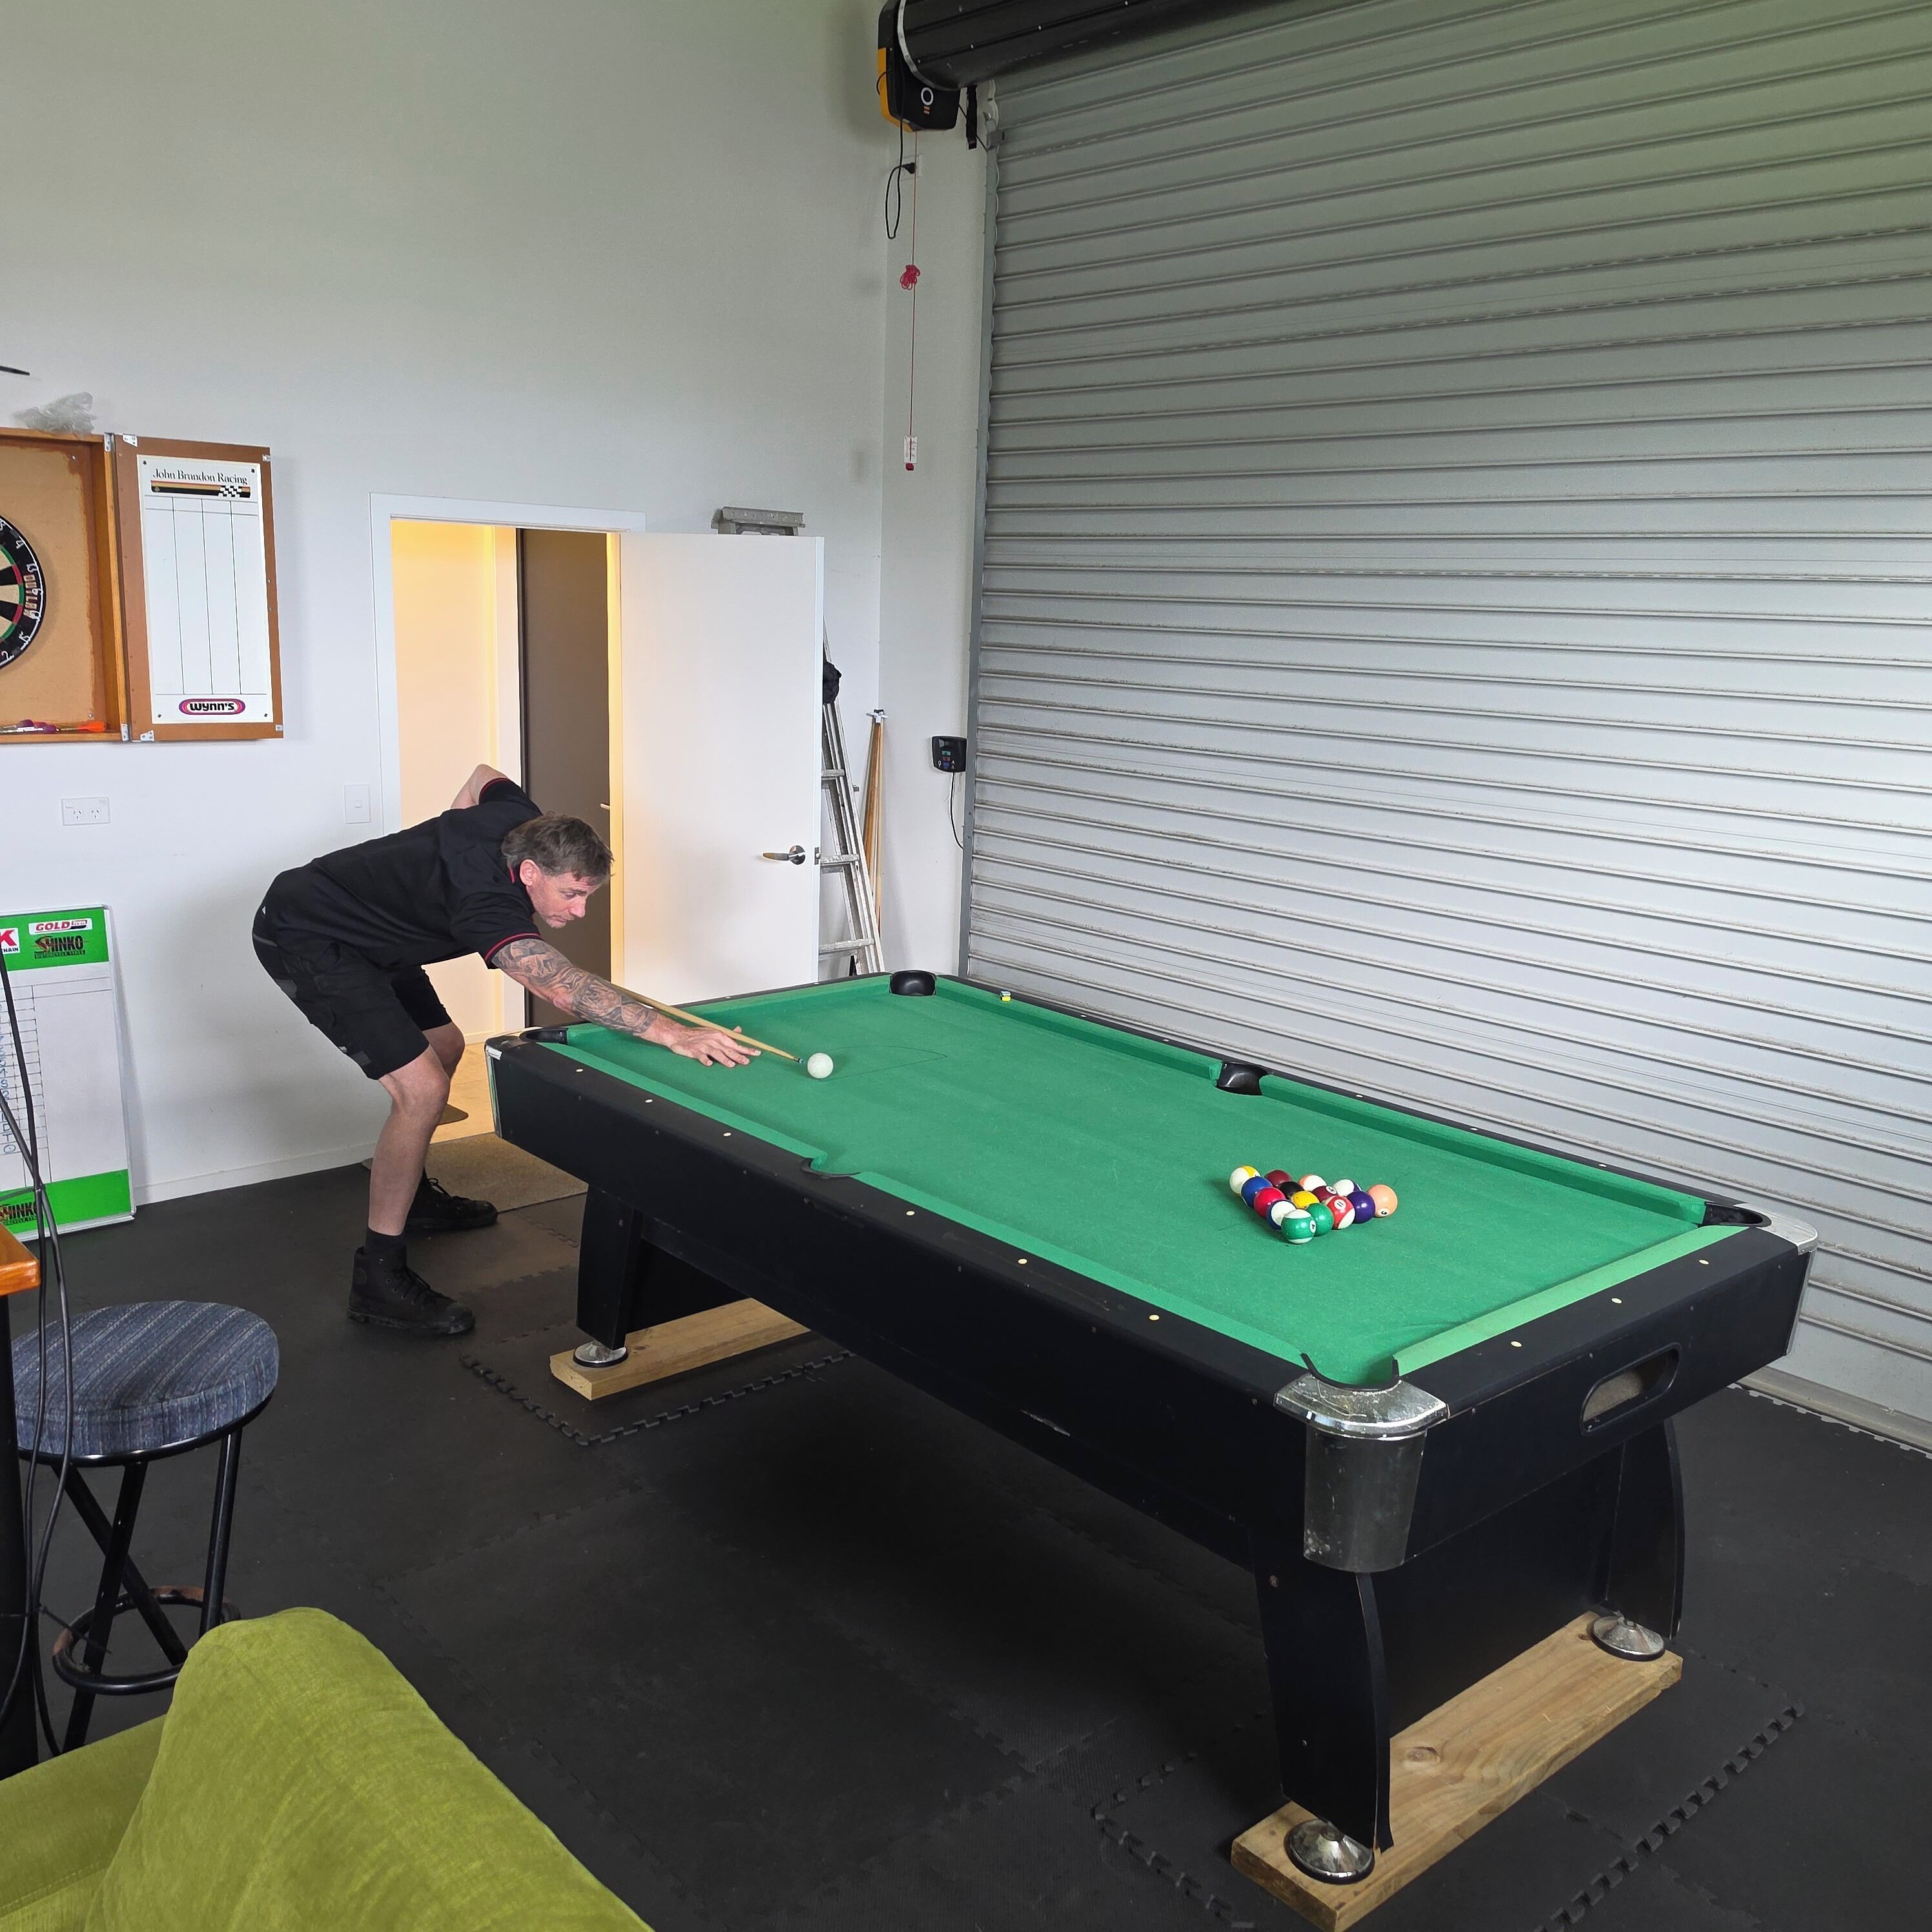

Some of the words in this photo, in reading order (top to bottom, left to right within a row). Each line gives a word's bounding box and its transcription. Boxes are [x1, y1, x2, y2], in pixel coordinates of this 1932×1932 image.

[152, 469, 176, 479] John
[178, 469, 216, 482] Brandon
[217, 472, 248, 486] Racing
[36, 921, 70, 931] GOLD
[34, 934, 84, 953] SHINKO
[3, 1133, 12, 1142] T
